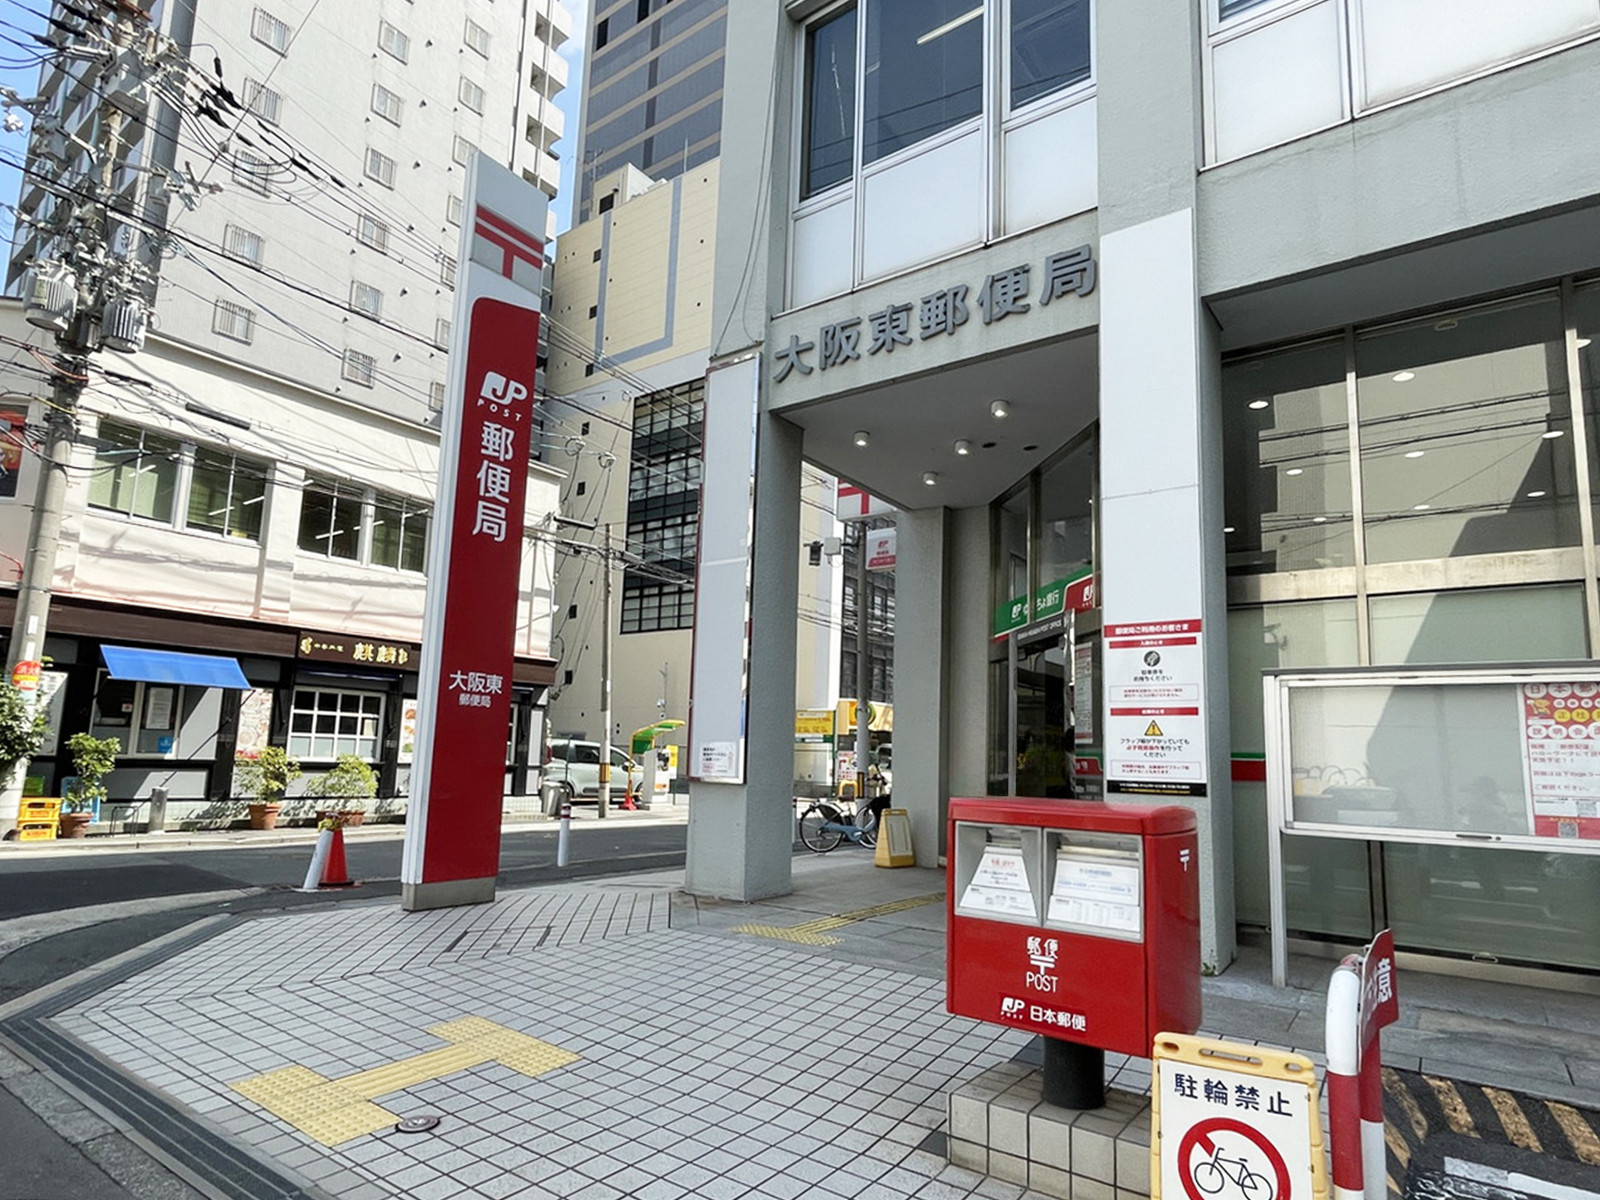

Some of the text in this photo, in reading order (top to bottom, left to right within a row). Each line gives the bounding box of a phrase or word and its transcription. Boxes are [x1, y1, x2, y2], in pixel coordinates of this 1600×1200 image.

[772, 243, 1097, 383] 大阪東郵便局
[477, 398, 523, 421] POST
[472, 421, 515, 542] 郵便局
[448, 670, 503, 694] 大阪東
[458, 692, 492, 709] 郵便局
[1027, 936, 1058, 959] 郵便
[1026, 971, 1059, 993] POST
[1030, 1005, 1086, 1032] 日本郵便
[1174, 1073, 1293, 1117] 駐輪禁止
